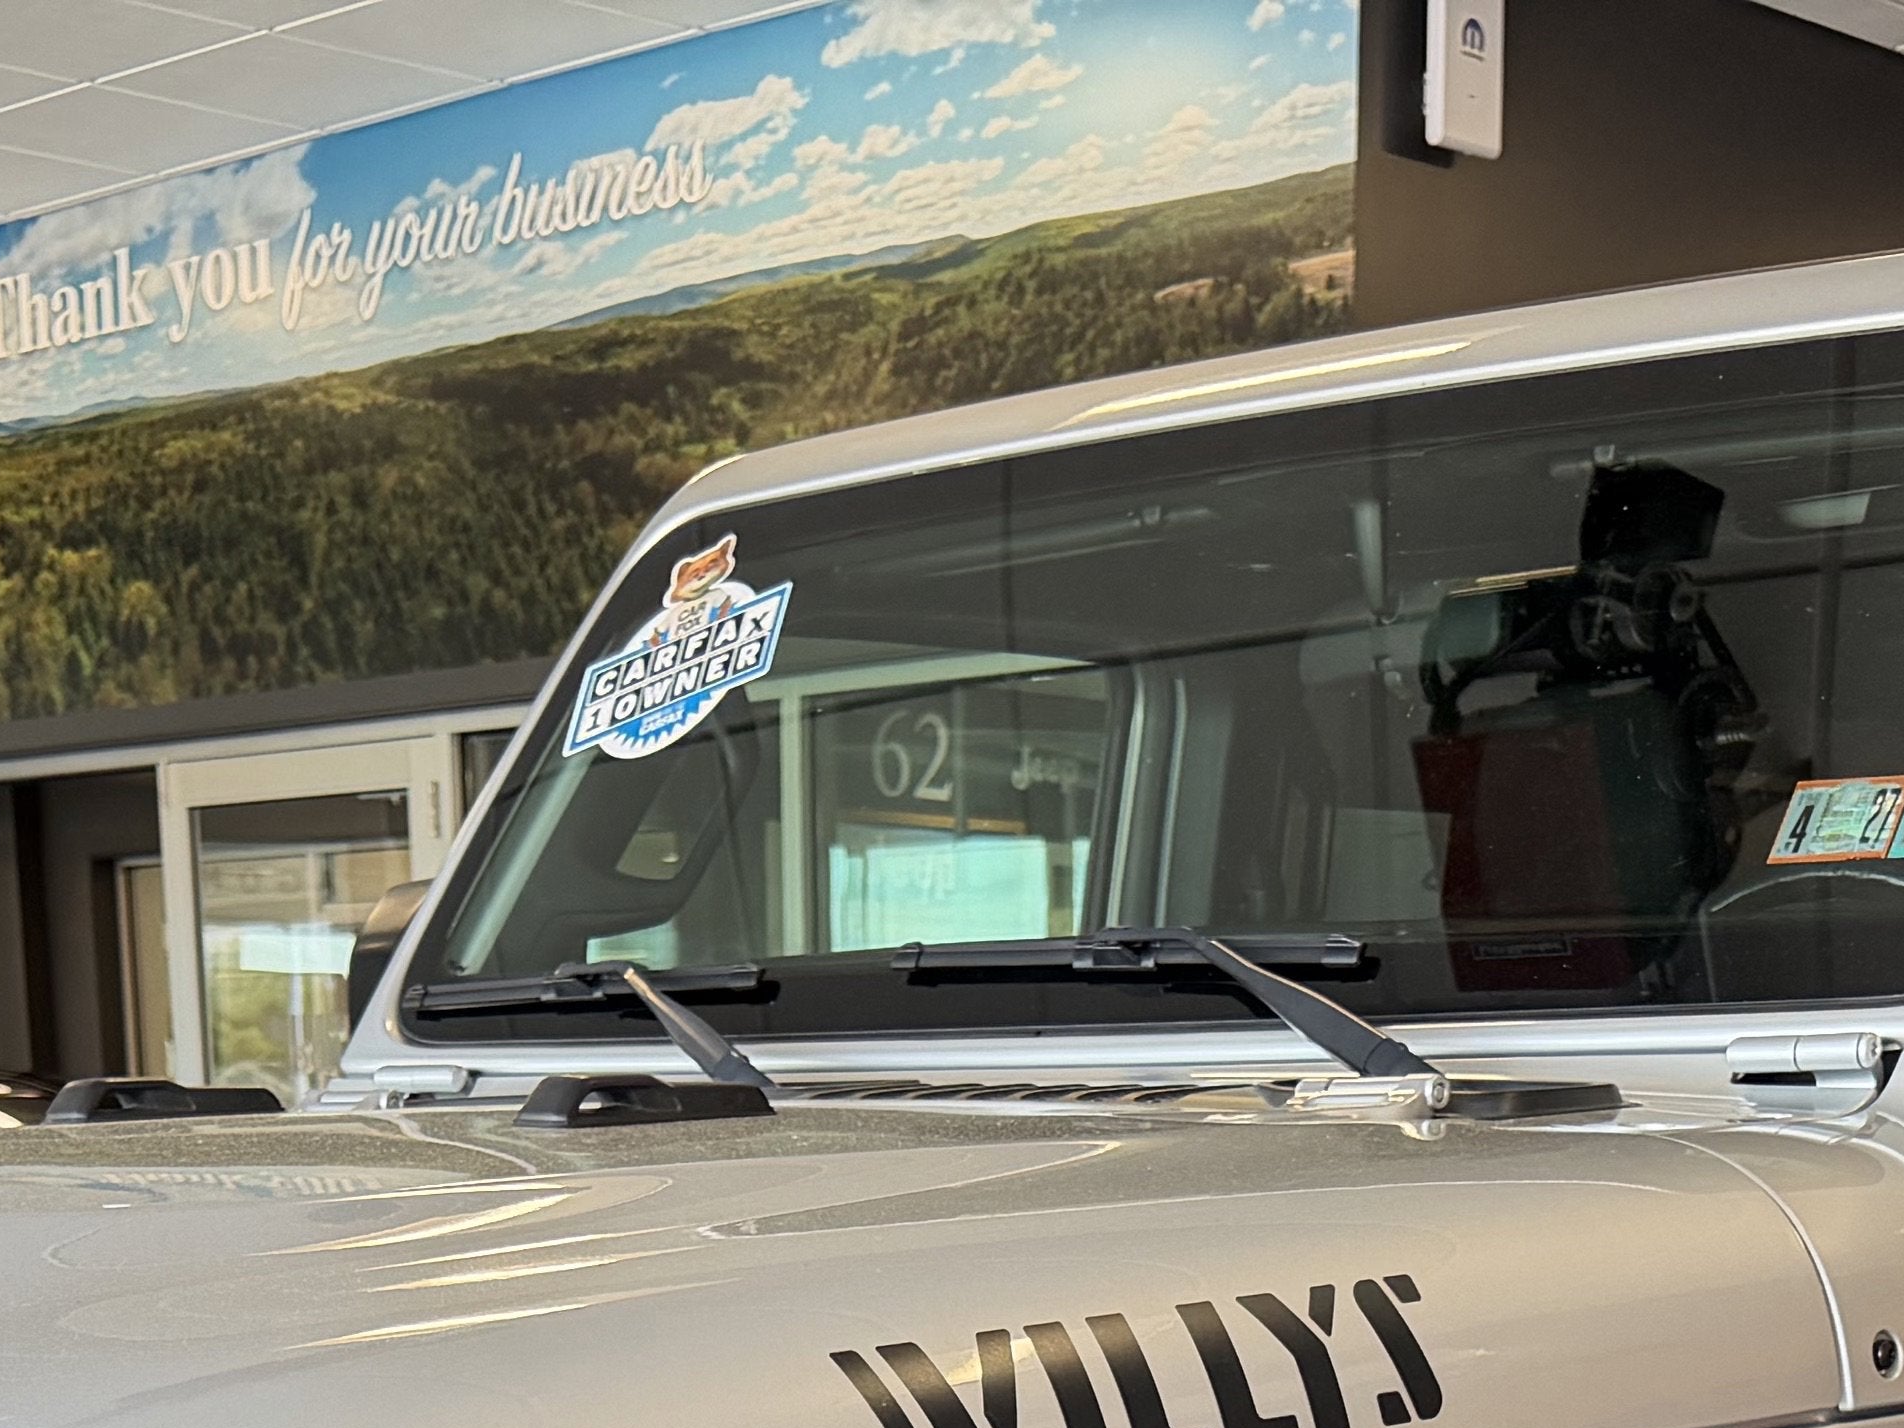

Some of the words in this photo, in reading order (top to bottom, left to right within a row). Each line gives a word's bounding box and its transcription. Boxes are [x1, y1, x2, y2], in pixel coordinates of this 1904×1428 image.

[169, 238, 274, 343] you
[281, 208, 353, 330] for
[360, 194, 483, 320] your
[493, 138, 715, 244] business
[594, 608, 770, 698] CARFAX
[678, 601, 706, 622] CAR
[586, 706, 603, 732] 1
[613, 641, 761, 720] OWNER
[872, 710, 954, 802] 62
[1788, 804, 1815, 853] 4
[1859, 787, 1902, 846] 27
